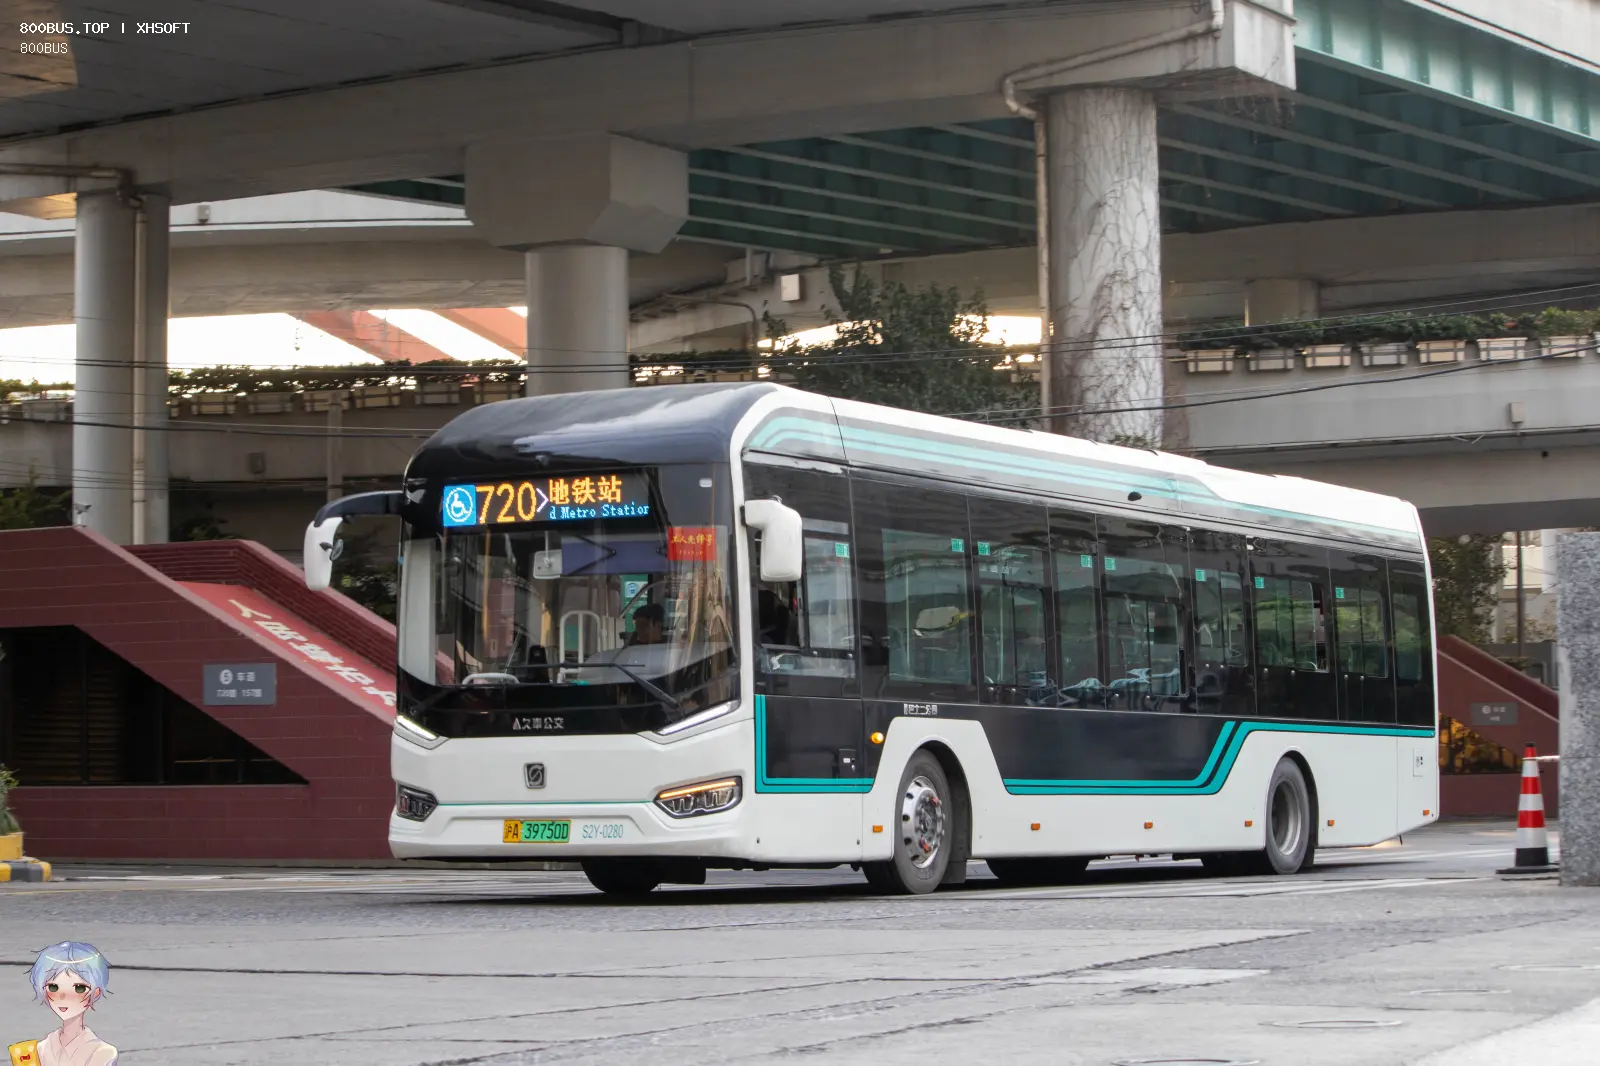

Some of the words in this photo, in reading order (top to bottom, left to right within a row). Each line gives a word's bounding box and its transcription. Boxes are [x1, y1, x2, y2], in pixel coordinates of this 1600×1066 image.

[549, 475, 622, 505] 地铁站
[475, 482, 537, 524] 720
[560, 507, 596, 520] Metro
[524, 823, 569, 839] 39750D
[582, 824, 624, 839] S2Y-0280
